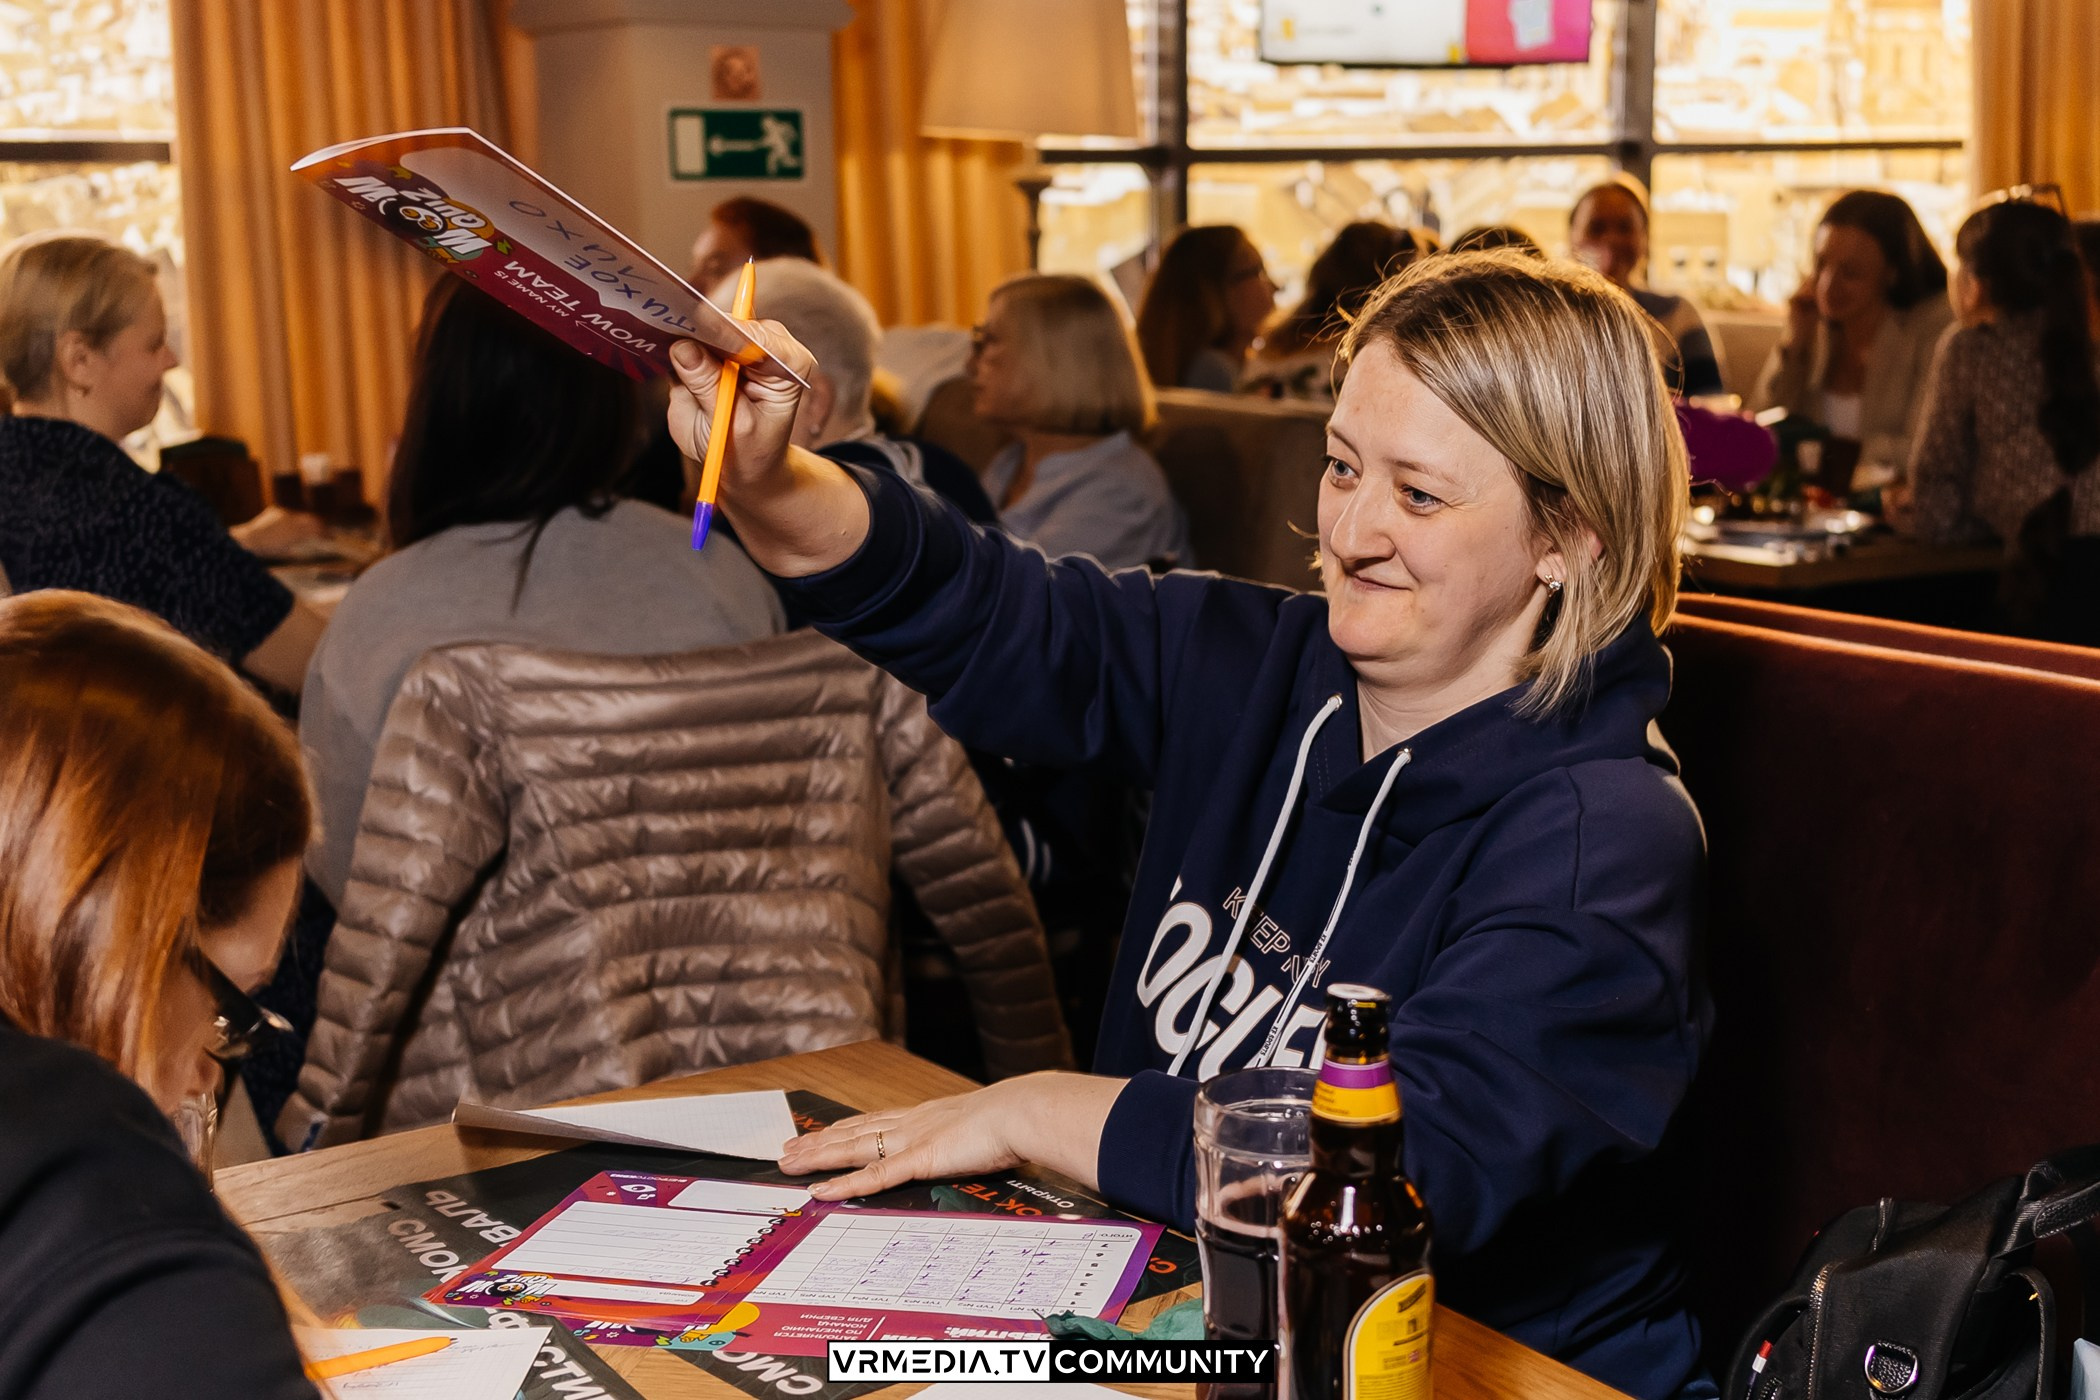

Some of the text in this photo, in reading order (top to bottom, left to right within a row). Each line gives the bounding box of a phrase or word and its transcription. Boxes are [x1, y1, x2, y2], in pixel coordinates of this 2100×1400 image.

[399, 187, 487, 228] QUIZ
[494, 269, 570, 317] MY NAME IS
[504, 260, 657, 353] WOW TEAM
[1222, 886, 1291, 955] KEP
[1260, 1033, 1275, 1057] SPORTS
[425, 1191, 523, 1248] ВАЛЬ
[781, 1325, 842, 1334] ЖЕЛАНИЮ
[800, 1313, 846, 1321] СВЕРКИ
[816, 1320, 868, 1329] КОМАНД
[773, 1331, 859, 1340] ЗАПОЛНЯЕТСЯ
